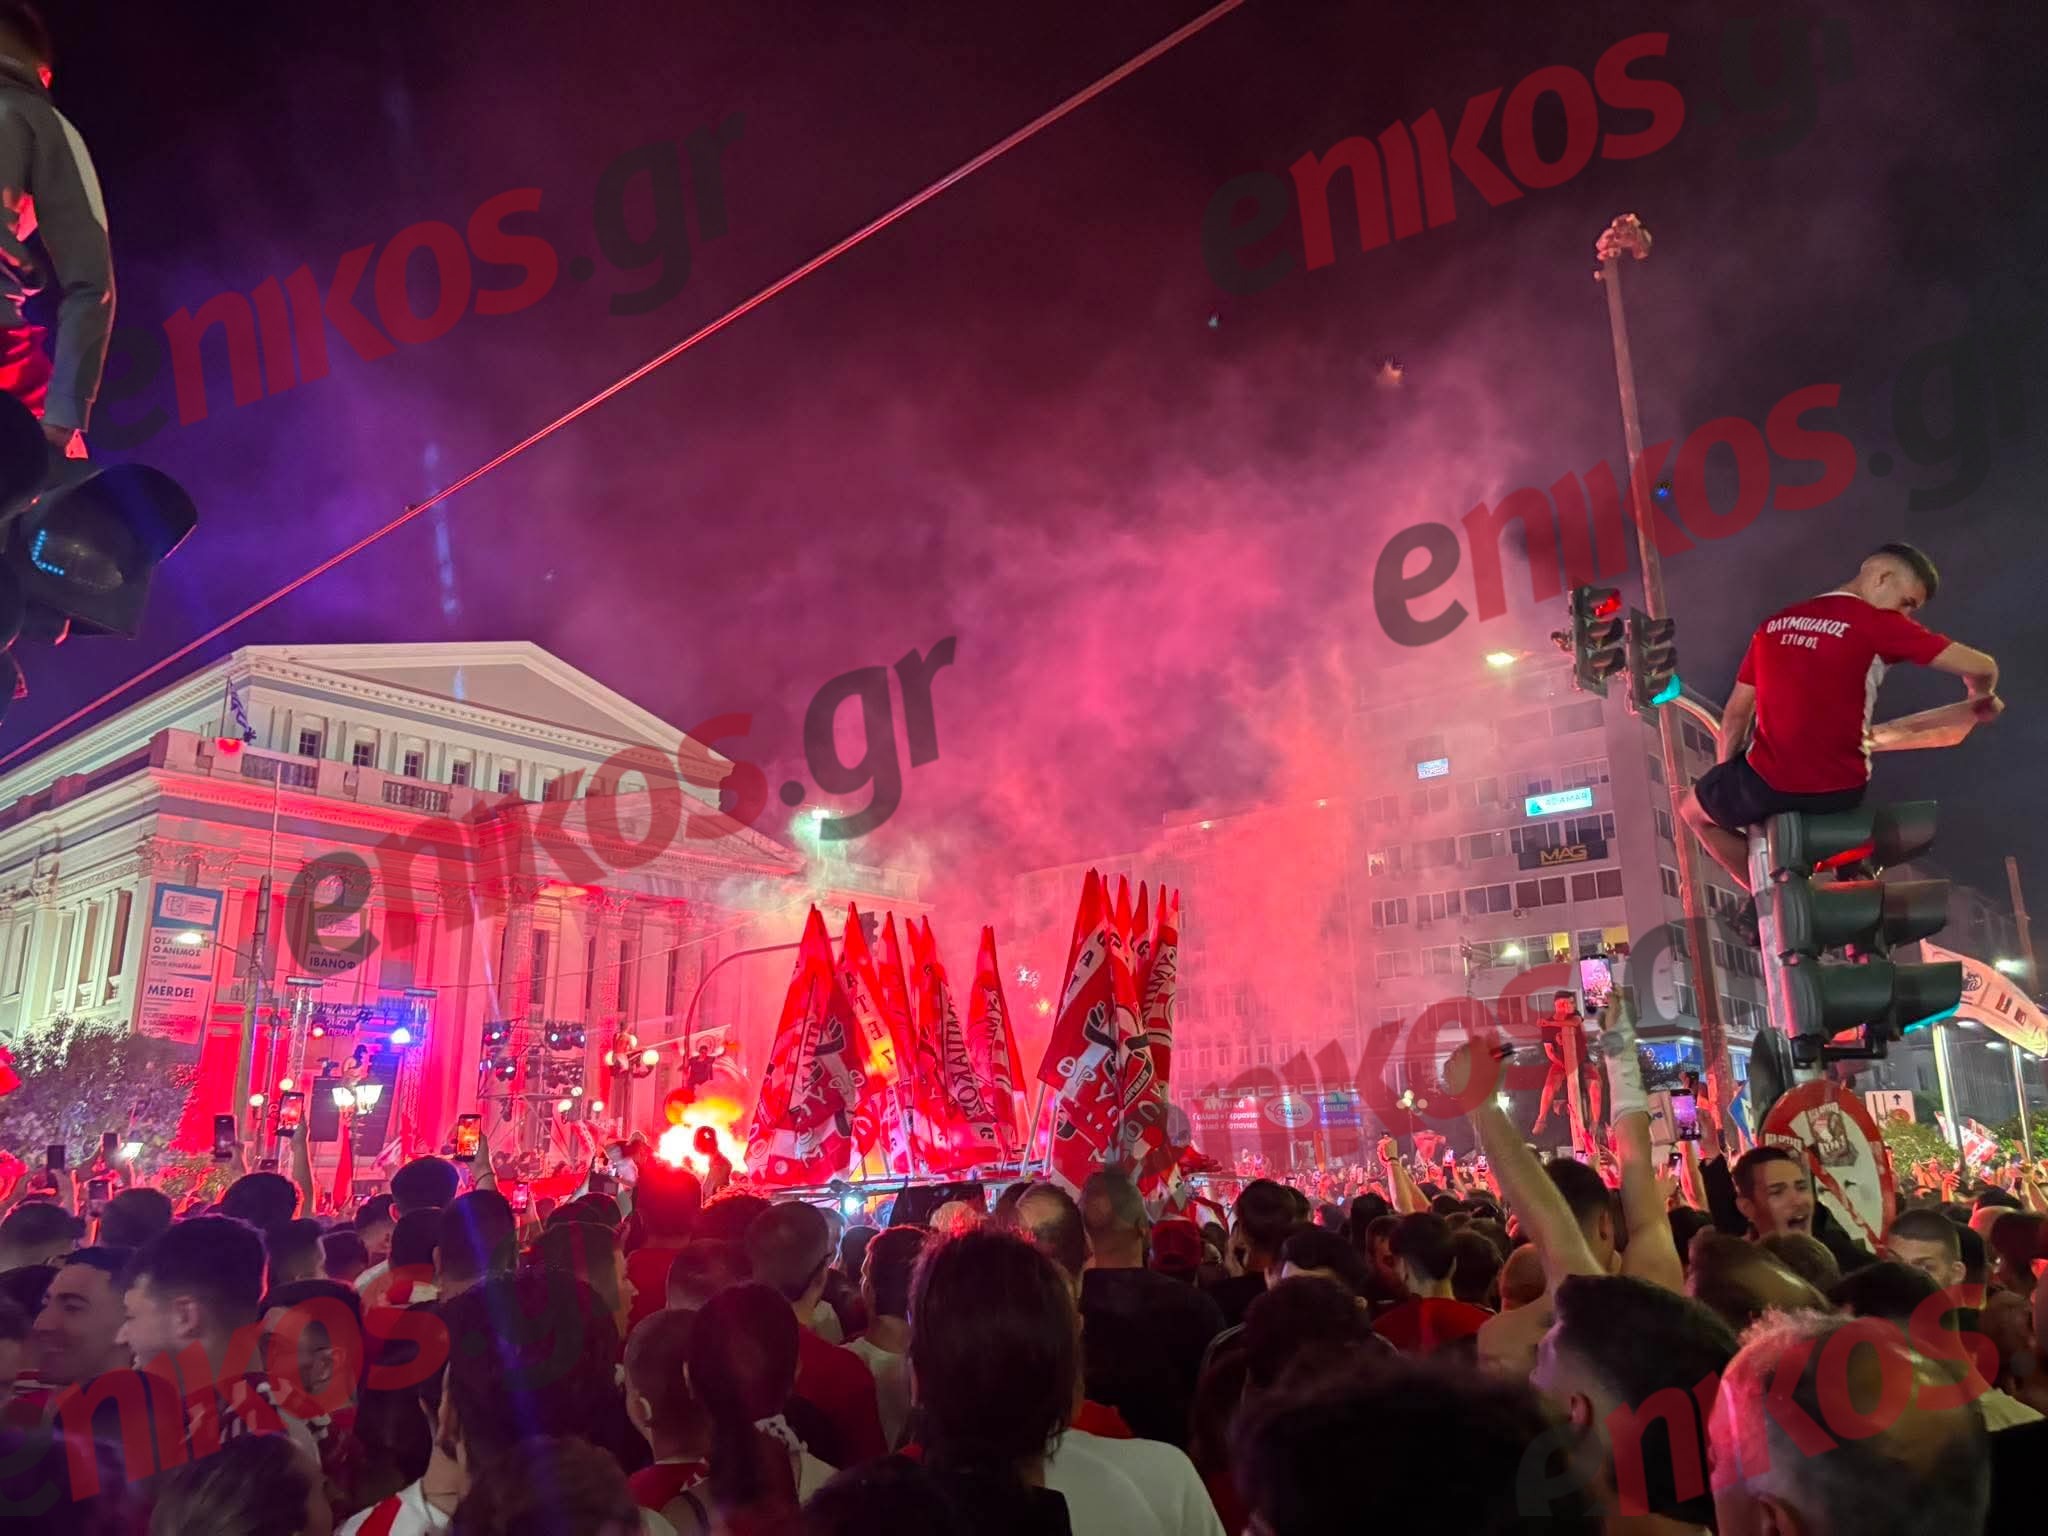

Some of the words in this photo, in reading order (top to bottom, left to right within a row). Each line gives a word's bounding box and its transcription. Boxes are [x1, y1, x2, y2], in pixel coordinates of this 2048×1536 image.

[1766, 615, 1852, 638] ΟΛΥΜΠΙΑΚΟΣ
[309, 956, 356, 970] ΙΒΑΝΟΦ
[147, 984, 194, 998] MERDE!
